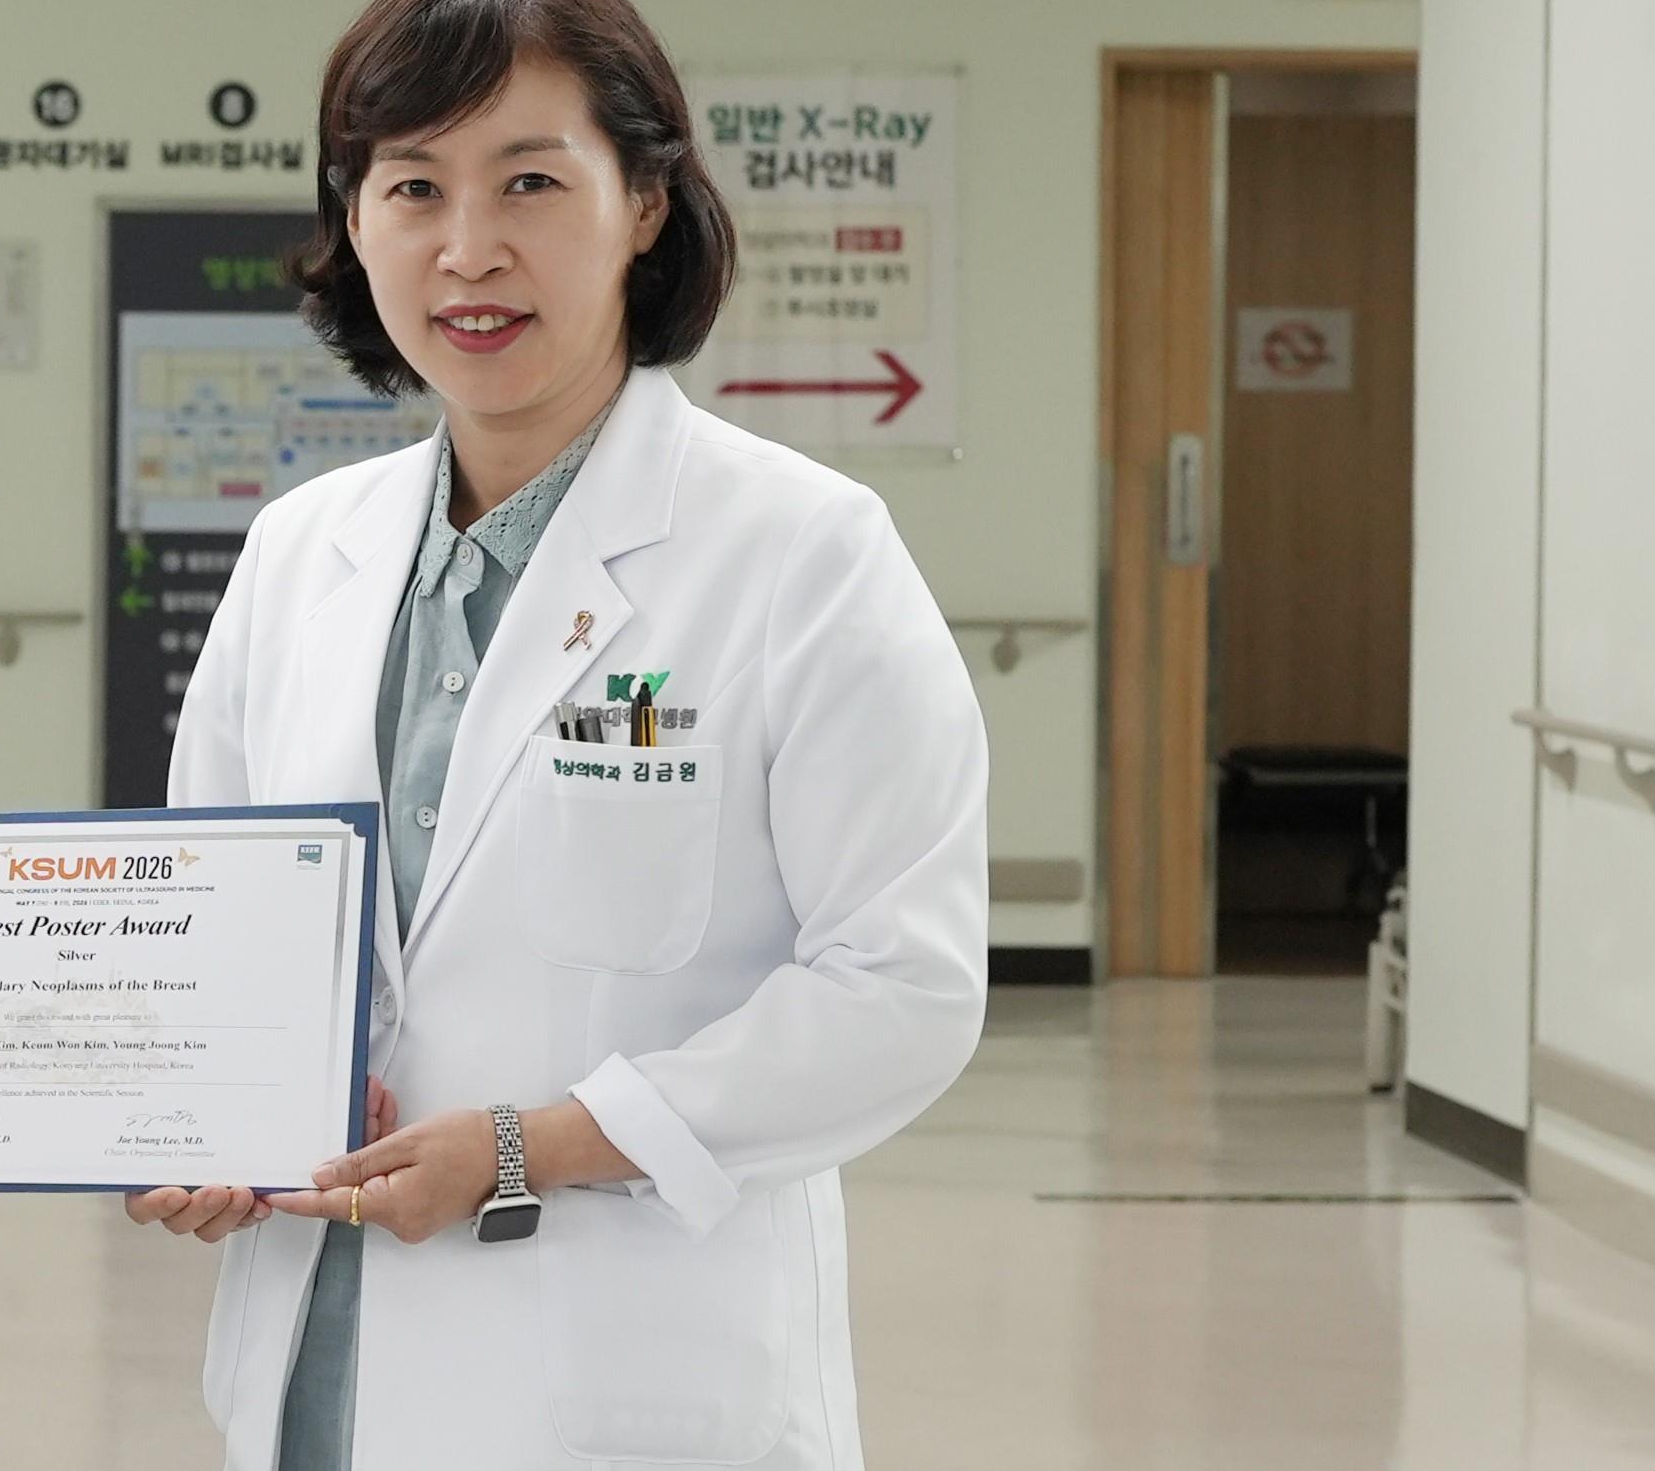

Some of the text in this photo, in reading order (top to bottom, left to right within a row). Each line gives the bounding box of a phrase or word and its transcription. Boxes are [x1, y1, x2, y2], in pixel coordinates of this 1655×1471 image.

[708, 103, 932, 150] 일반 X-Ray
[744, 149, 896, 191] 검사안내
[7, 855, 174, 881] KSUM 2026
[28, 915, 106, 937] Poster
[110, 914, 192, 937] Award
[57, 949, 96, 961] Silver
[31, 980, 104, 994] Neoplasms
[109, 979, 123, 991] of
[127, 979, 148, 991] the
[153, 979, 196, 991] Breast
[57, 1040, 80, 1050] Won
[113, 1040, 146, 1051] Young
[149, 1040, 180, 1051] Joong
[184, 1040, 207, 1050] Kim
[183, 1136, 205, 1145] M.D.
